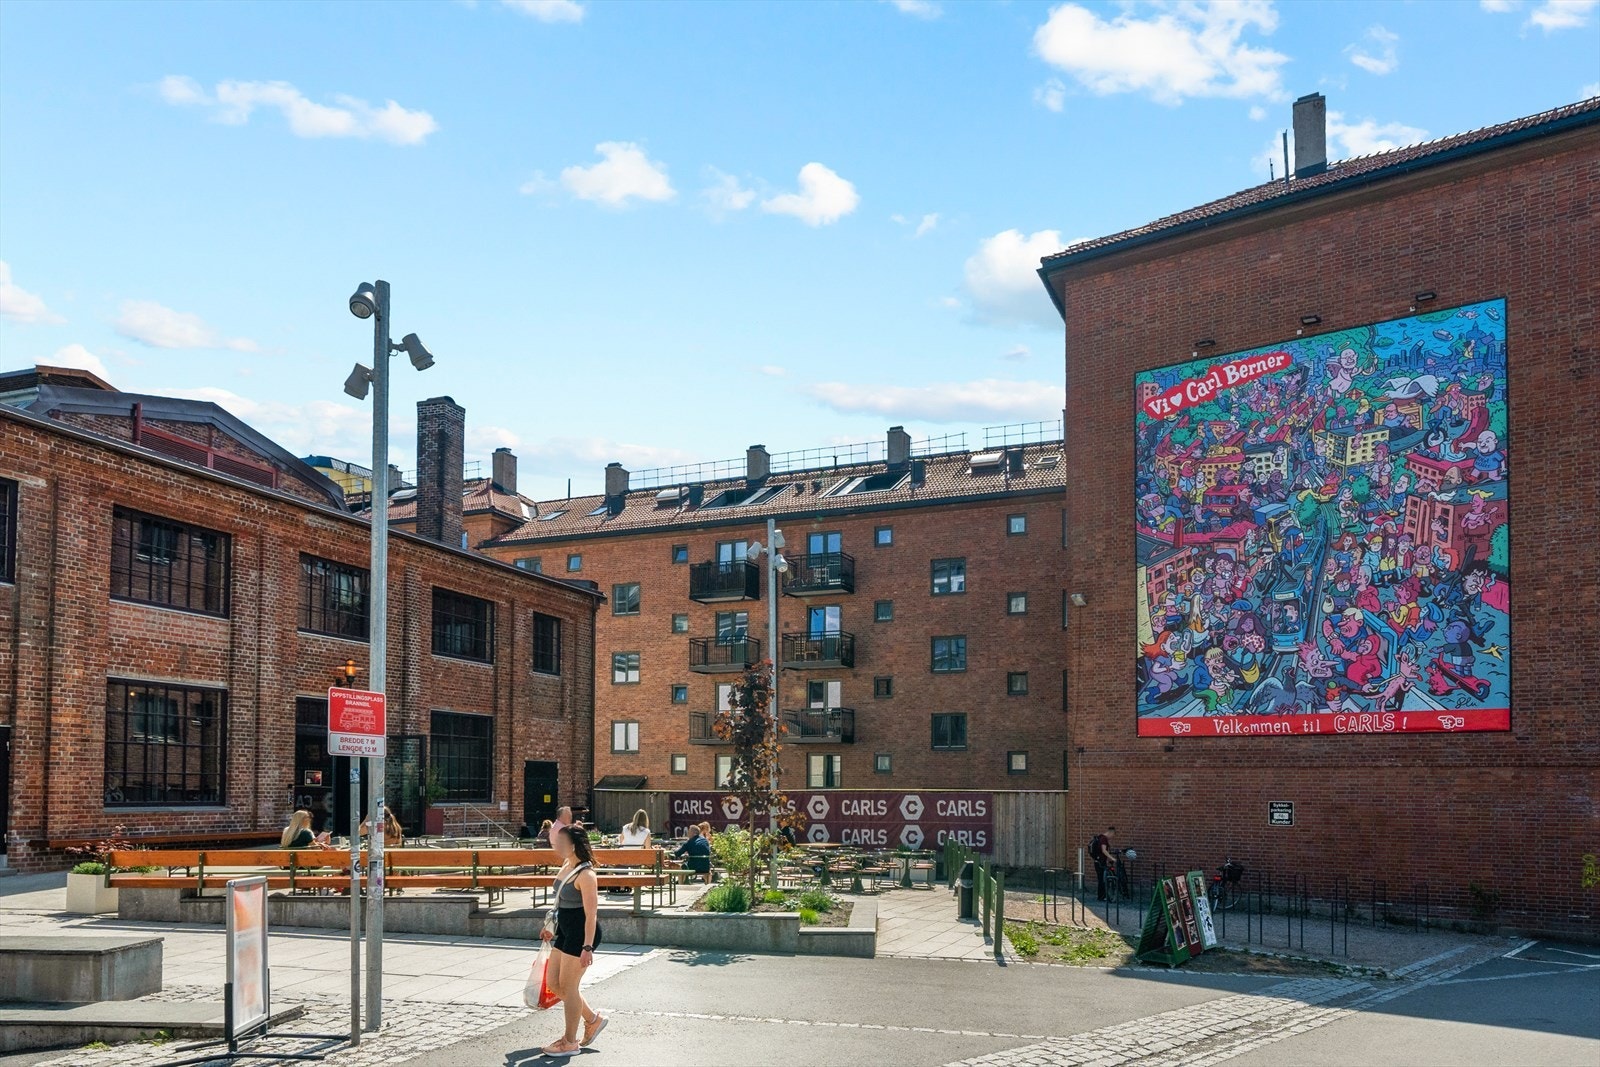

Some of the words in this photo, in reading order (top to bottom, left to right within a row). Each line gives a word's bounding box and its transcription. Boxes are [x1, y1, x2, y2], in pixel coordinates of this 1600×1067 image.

[1148, 398, 1171, 415] Vi
[1186, 371, 1223, 402] Carl
[1223, 354, 1285, 385] Berner
[332, 692, 383, 702] OPPSTILLINGSPLASS
[1213, 718, 1292, 734] Velkommen
[1303, 719, 1321, 733] til
[1334, 713, 1395, 733] CARLS
[674, 800, 713, 815] CARLS
[841, 799, 888, 816] CARLS
[936, 800, 987, 817] CARLS
[841, 828, 888, 845] CARLS
